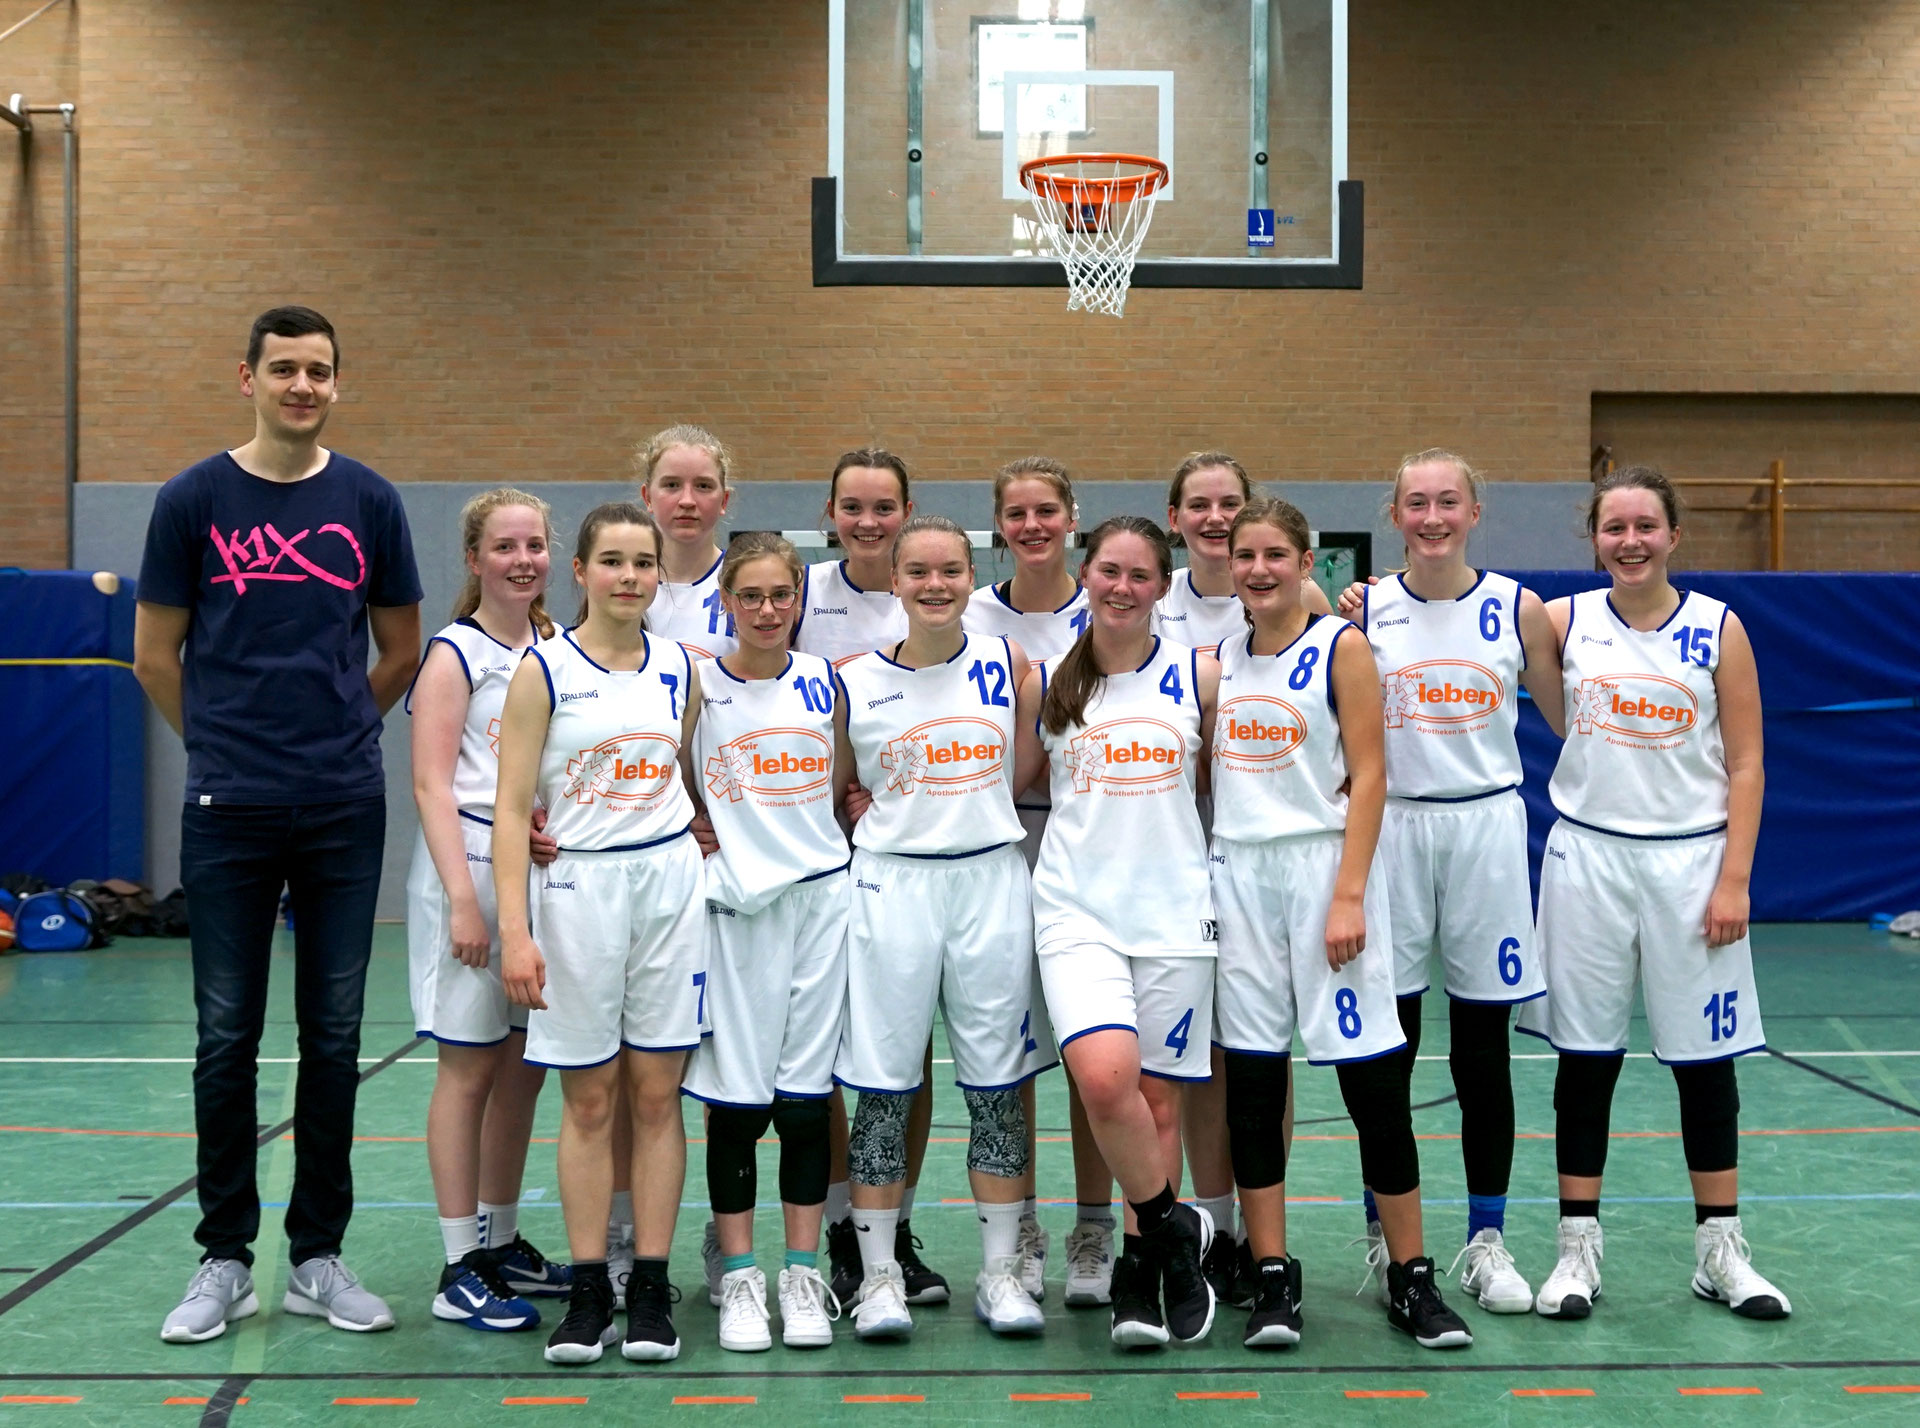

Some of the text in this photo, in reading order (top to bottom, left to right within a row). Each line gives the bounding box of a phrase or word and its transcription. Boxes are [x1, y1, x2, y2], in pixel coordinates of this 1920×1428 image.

[813, 607, 848, 616] SPALDING
[1377, 617, 1410, 629] SPALDING
[1479, 597, 1503, 642] 6
[1672, 625, 1713, 667] 15
[1288, 646, 1320, 691] 8
[793, 675, 833, 714] 10
[967, 659, 1009, 709] 12
[1159, 664, 1184, 705] 4
[1418, 683, 1497, 707] leben
[1600, 681, 1620, 690] wir
[560, 690, 599, 703] SPALDING
[659, 672, 678, 720] 7
[867, 691, 904, 710] SPALDING
[1222, 707, 1236, 715] wir
[1611, 694, 1694, 724] leben
[909, 733, 929, 743] wir
[1089, 732, 1109, 741] wir
[1229, 719, 1299, 743] leben
[1416, 725, 1457, 736] Apotheken
[602, 747, 622, 756] wir
[738, 742, 758, 751] wir
[926, 741, 1002, 765] leben
[1105, 741, 1180, 764] leben
[1605, 736, 1646, 750] Apotheken
[753, 752, 829, 775] leben
[1225, 763, 1265, 774] Apotheken
[756, 797, 796, 807] Apotheken
[926, 787, 968, 797] Apotheken
[1102, 788, 1144, 797] Apotheken
[1498, 936, 1522, 986] 6
[692, 971, 706, 1025] 7
[1335, 987, 1362, 1039] 8
[1703, 990, 1738, 1042] 15
[1165, 1008, 1194, 1058] 4
